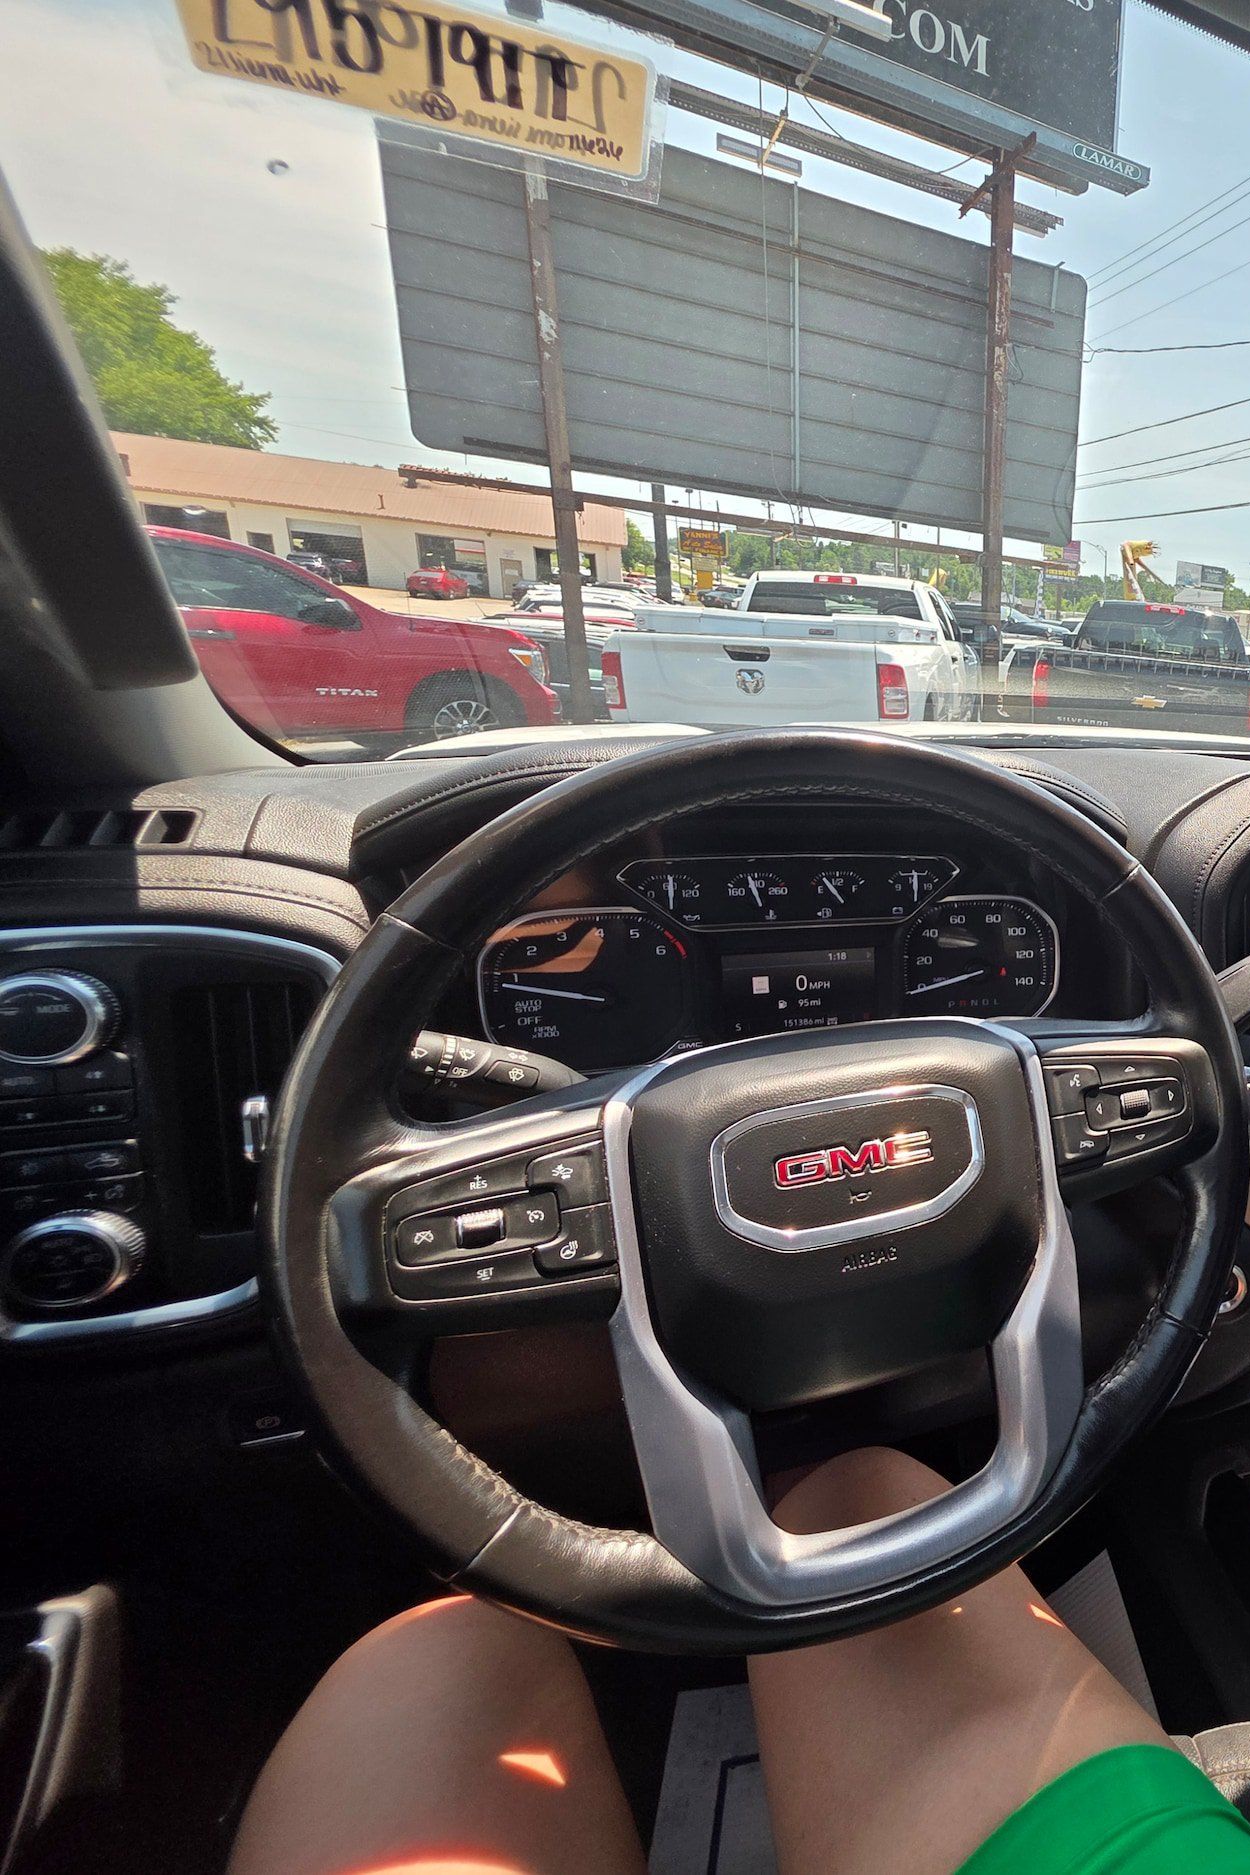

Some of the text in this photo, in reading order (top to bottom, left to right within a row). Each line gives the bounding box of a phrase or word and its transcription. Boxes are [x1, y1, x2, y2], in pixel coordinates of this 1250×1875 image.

[1081, 147, 1135, 177] LAMAR
[315, 687, 379, 698] TITAN
[768, 886, 788, 896] 260
[817, 885, 824, 894] E
[851, 884, 858, 893] F
[895, 883, 901, 892] 9
[923, 882, 933, 891] 19
[682, 888, 700, 898] 120
[728, 887, 746, 897] 160
[949, 914, 966, 924] 60
[985, 914, 1001, 923] 80
[556, 931, 568, 942] 3
[594, 928, 605, 938] 4
[629, 929, 640, 939] 5
[922, 928, 939, 938] 40
[1007, 927, 1027, 936] 100
[526, 946, 538, 956] 2
[655, 945, 667, 955] 6
[1016, 950, 1034, 959] 120
[828, 952, 847, 961] 1:18
[916, 956, 933, 965] 20
[512, 973, 519, 983] 1
[795, 974, 831, 991] 0 MPH
[1015, 976, 1034, 986] 140
[514, 999, 542, 1008] AUTO
[36, 1004, 71, 1014] MODE
[514, 1005, 542, 1014] STOP
[517, 1016, 543, 1026] OFF
[677, 1041, 704, 1050] GMC
[451, 1066, 469, 1077] OFF
[774, 1130, 934, 1190] GMC
[469, 1179, 488, 1190] RES
[841, 1246, 898, 1273] AIRBAG
[476, 1267, 495, 1279] SET
